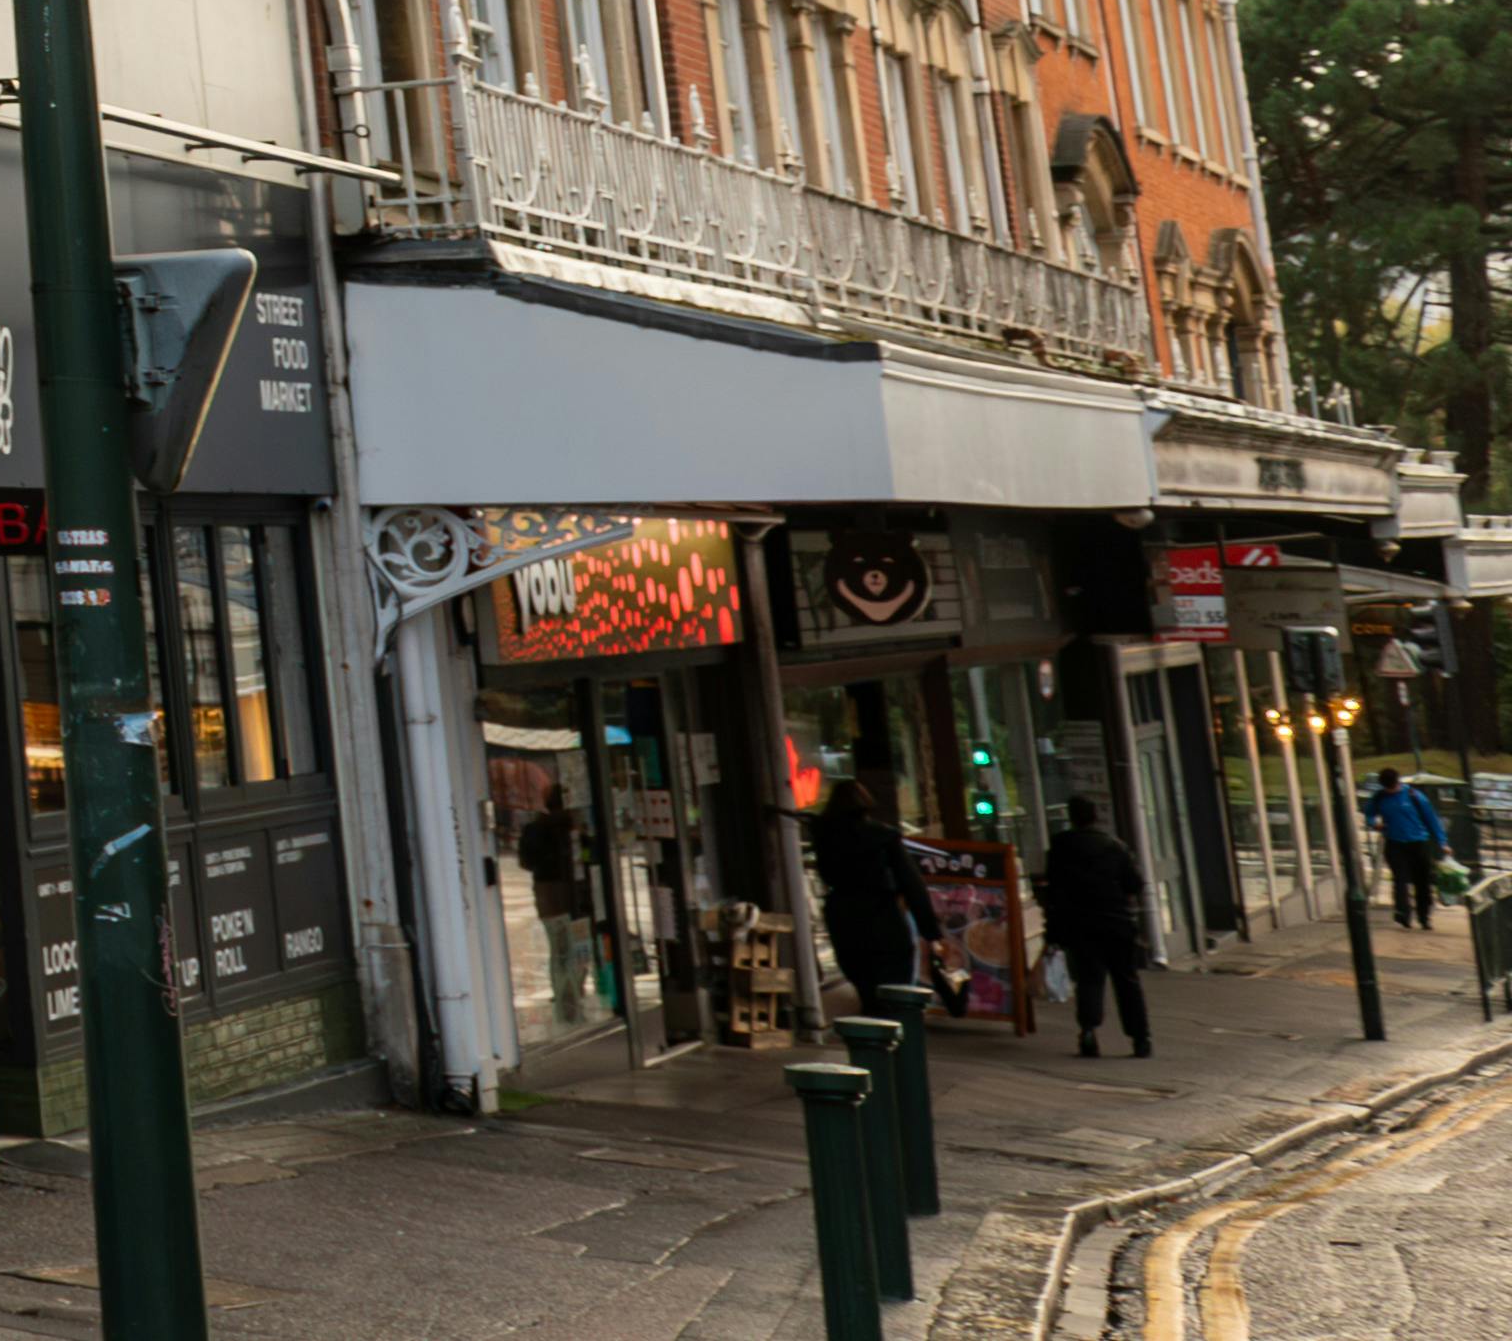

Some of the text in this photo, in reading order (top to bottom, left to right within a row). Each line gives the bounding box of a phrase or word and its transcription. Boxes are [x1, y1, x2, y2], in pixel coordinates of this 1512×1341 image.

[256, 292, 304, 327] STREET
[272, 337, 309, 370] FOOD
[260, 379, 312, 413] MARKET
[284, 925, 324, 959] RANGO
[215, 945, 248, 978] ROLL
